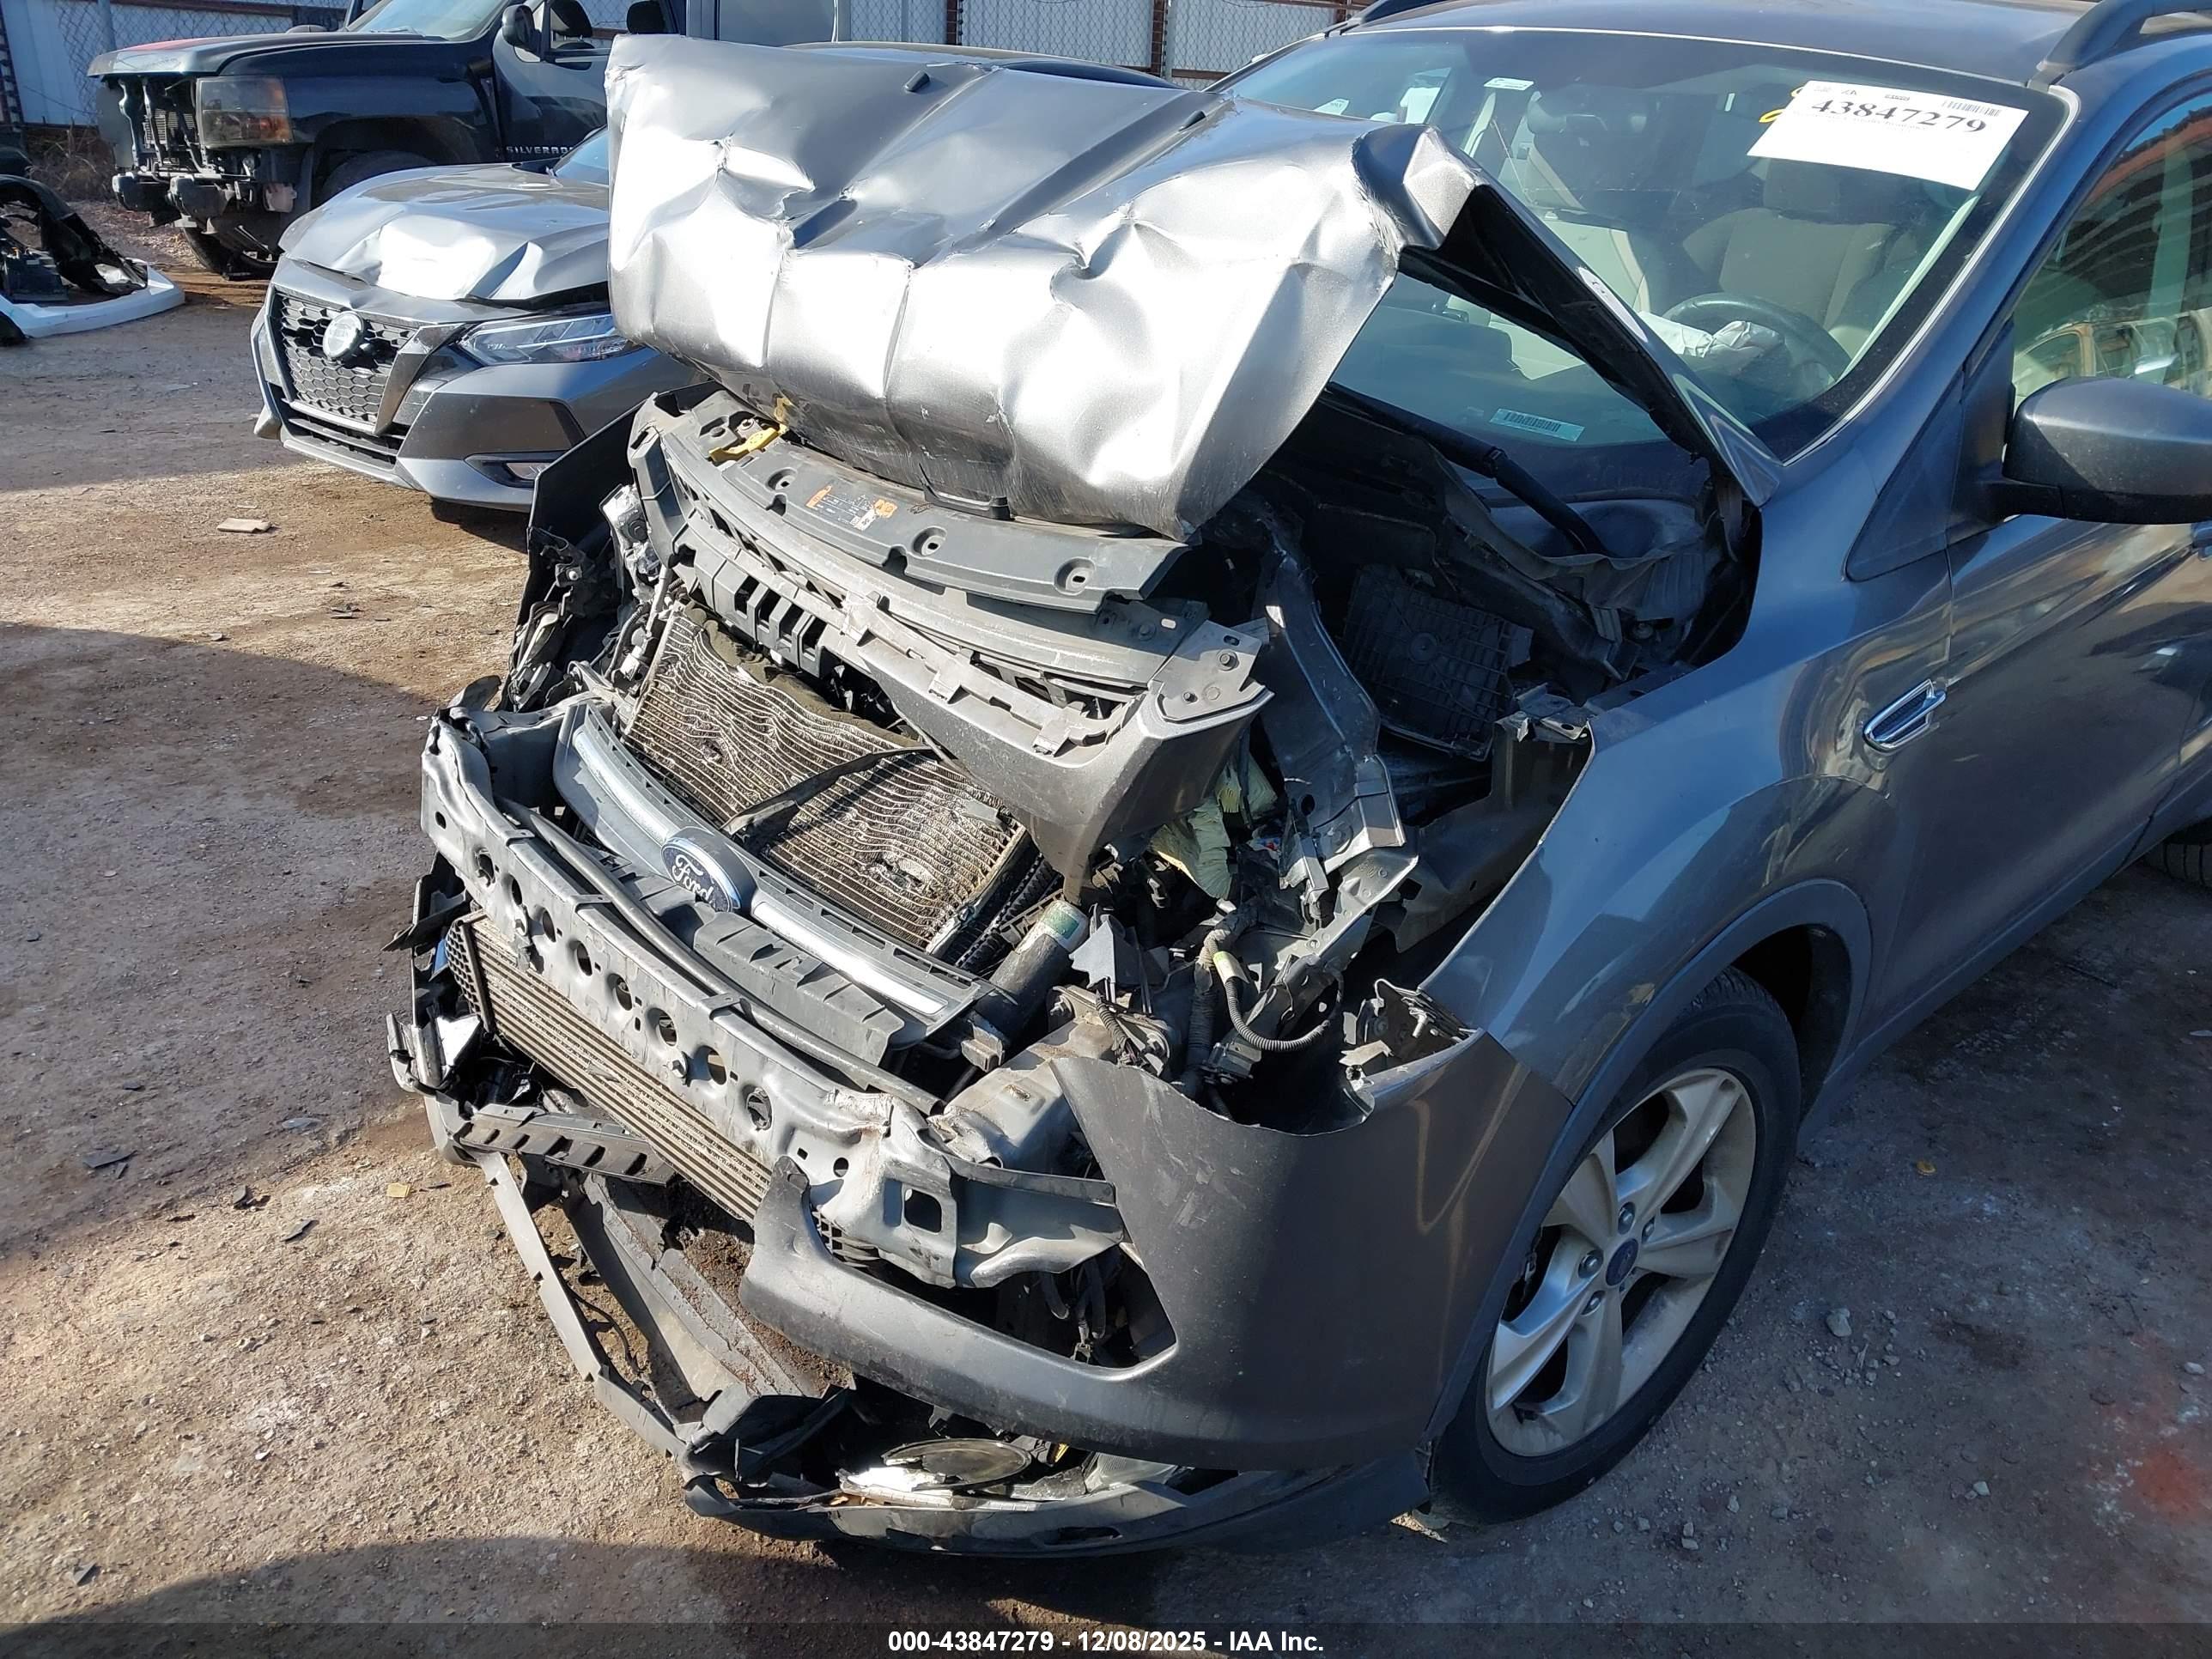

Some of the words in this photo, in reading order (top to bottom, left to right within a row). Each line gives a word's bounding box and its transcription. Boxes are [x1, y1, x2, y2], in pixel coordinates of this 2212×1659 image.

[1812, 99, 1987, 133] 43847279
[506, 145, 574, 155] SILVERAD
[672, 854, 715, 905] Ford
